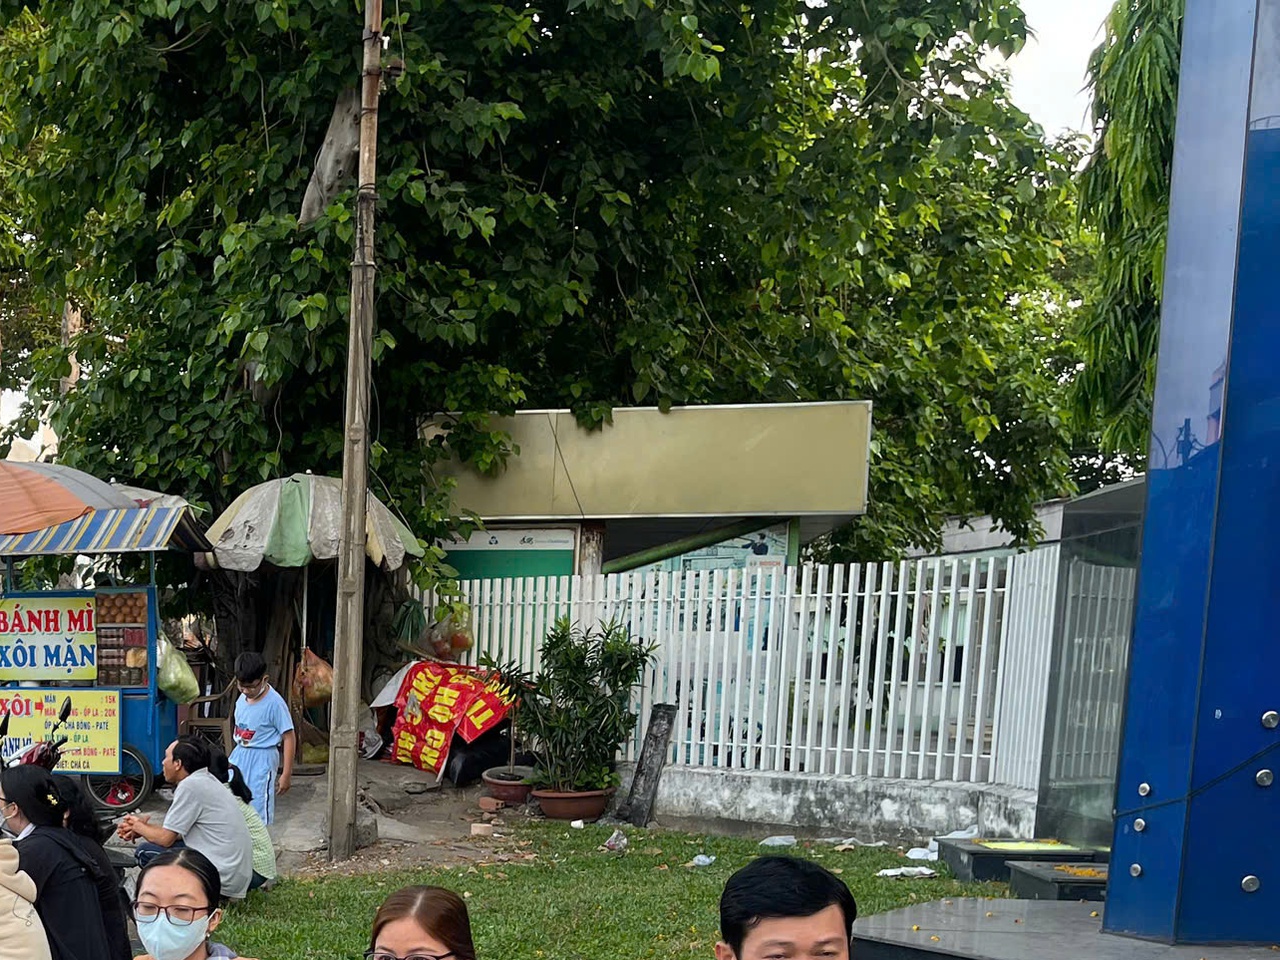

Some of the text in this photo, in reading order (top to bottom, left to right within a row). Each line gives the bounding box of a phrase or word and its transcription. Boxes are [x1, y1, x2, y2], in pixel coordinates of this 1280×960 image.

[67, 602, 94, 632] MÌ
[43, 637, 96, 674] MẶN
[105, 695, 117, 704] 15K
